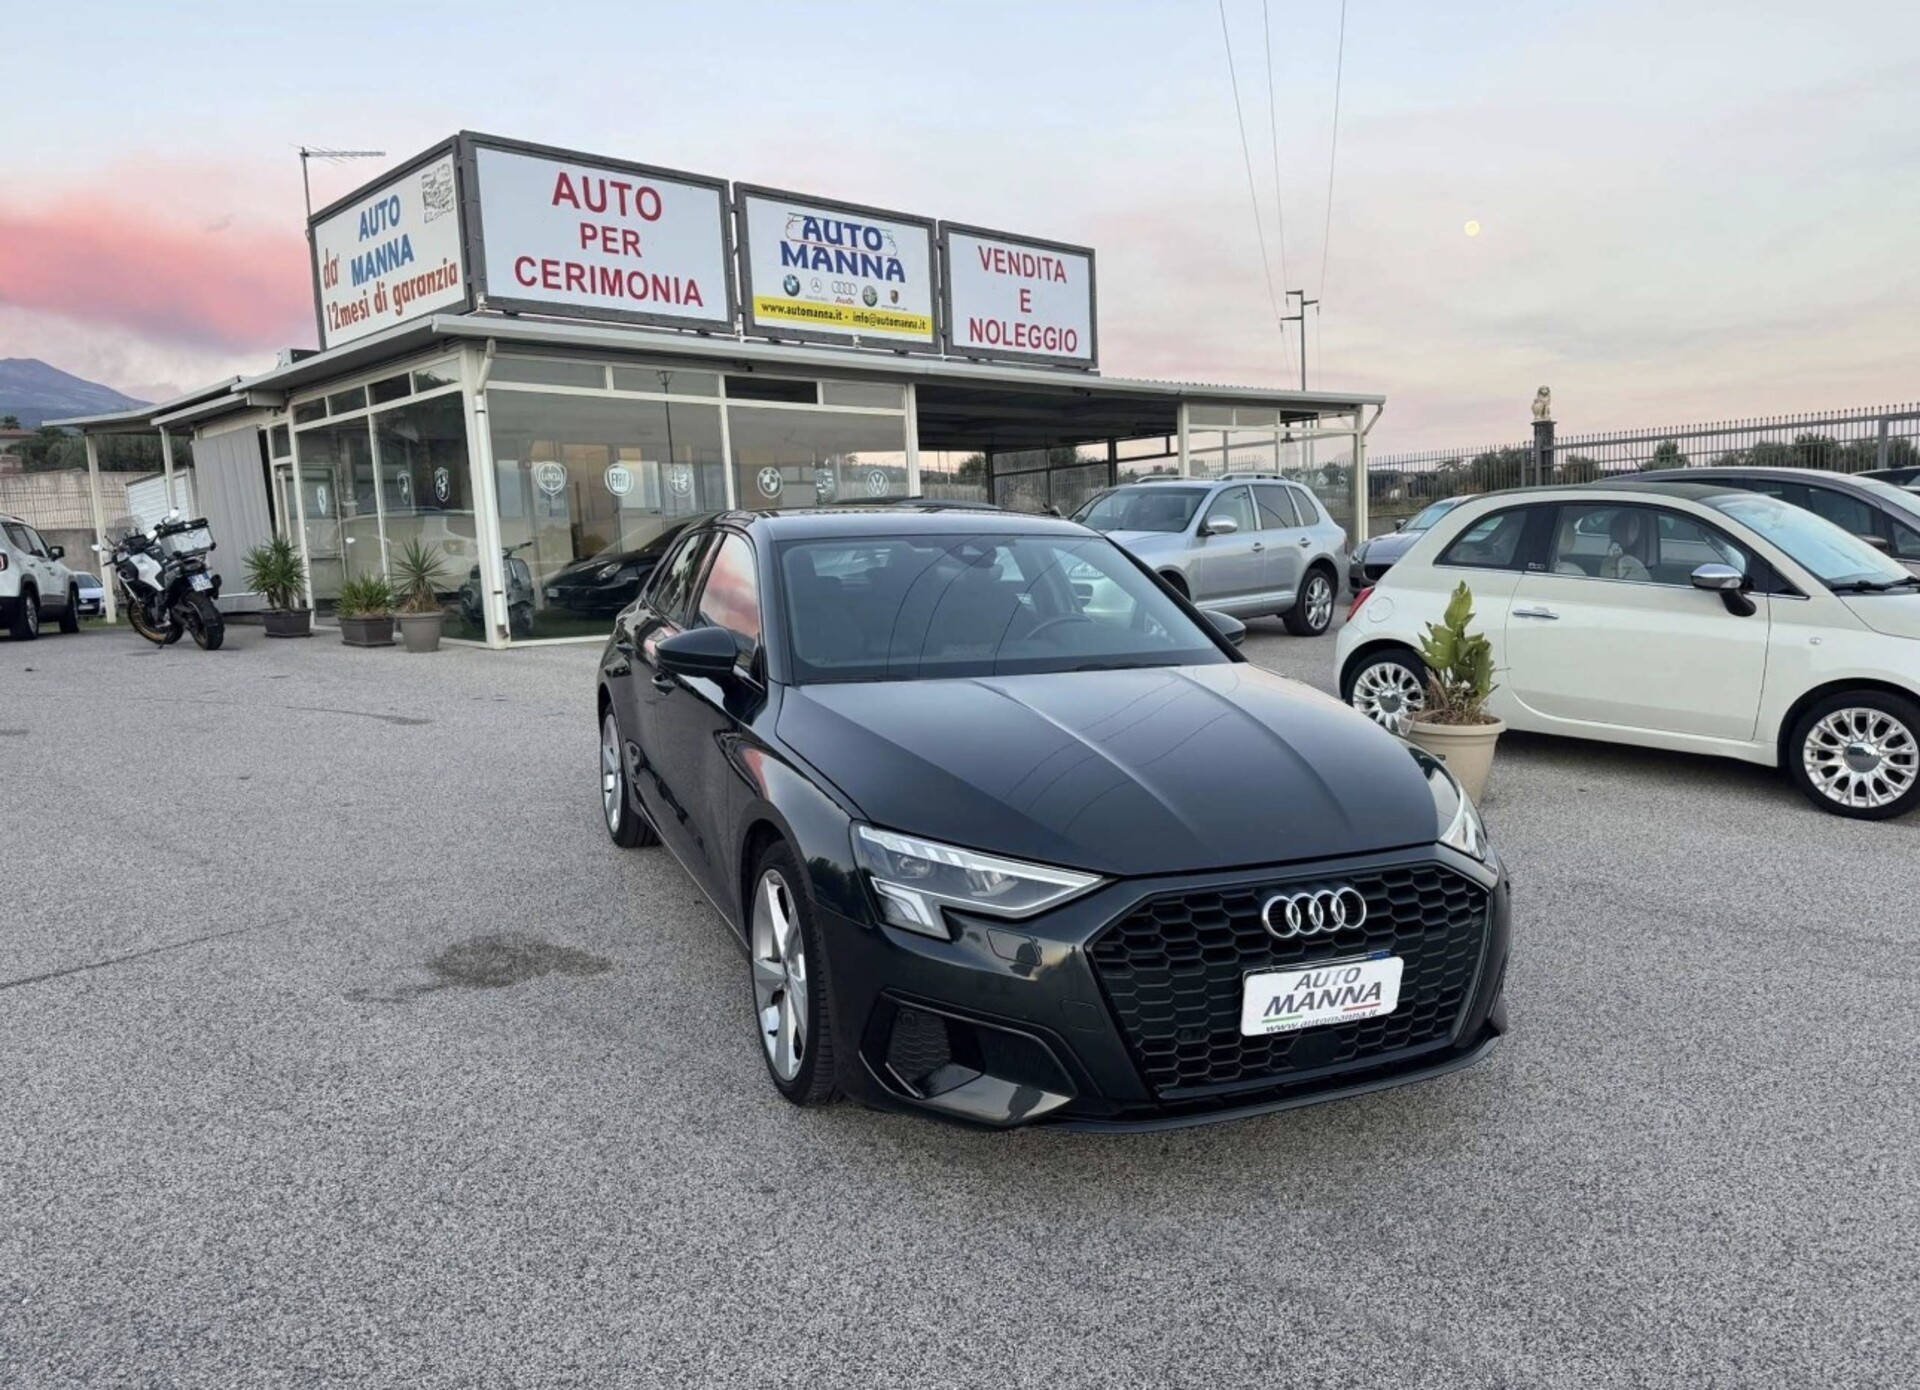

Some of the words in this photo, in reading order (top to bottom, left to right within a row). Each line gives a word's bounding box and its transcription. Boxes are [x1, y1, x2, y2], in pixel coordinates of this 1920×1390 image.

[552, 172, 662, 222] AUTO
[359, 194, 400, 242] AUTO
[803, 215, 883, 252] AUTO
[580, 222, 642, 258] PER
[351, 233, 414, 287] MANNA
[780, 240, 905, 283] MANNA
[978, 245, 1067, 284] VENDITA
[374, 281, 388, 314] di
[392, 257, 458, 317] garanzia
[514, 256, 703, 307] CERIMONIA
[761, 302, 843, 321] www.automanna.it
[853, 311, 926, 330] info@automanna.it
[1020, 288, 1032, 313] E
[969, 316, 1077, 353] NOLEGGIO
[1294, 967, 1361, 991] AUTO
[1263, 982, 1382, 1017] MANNA
[1266, 1009, 1377, 1033] www.automanna.it
